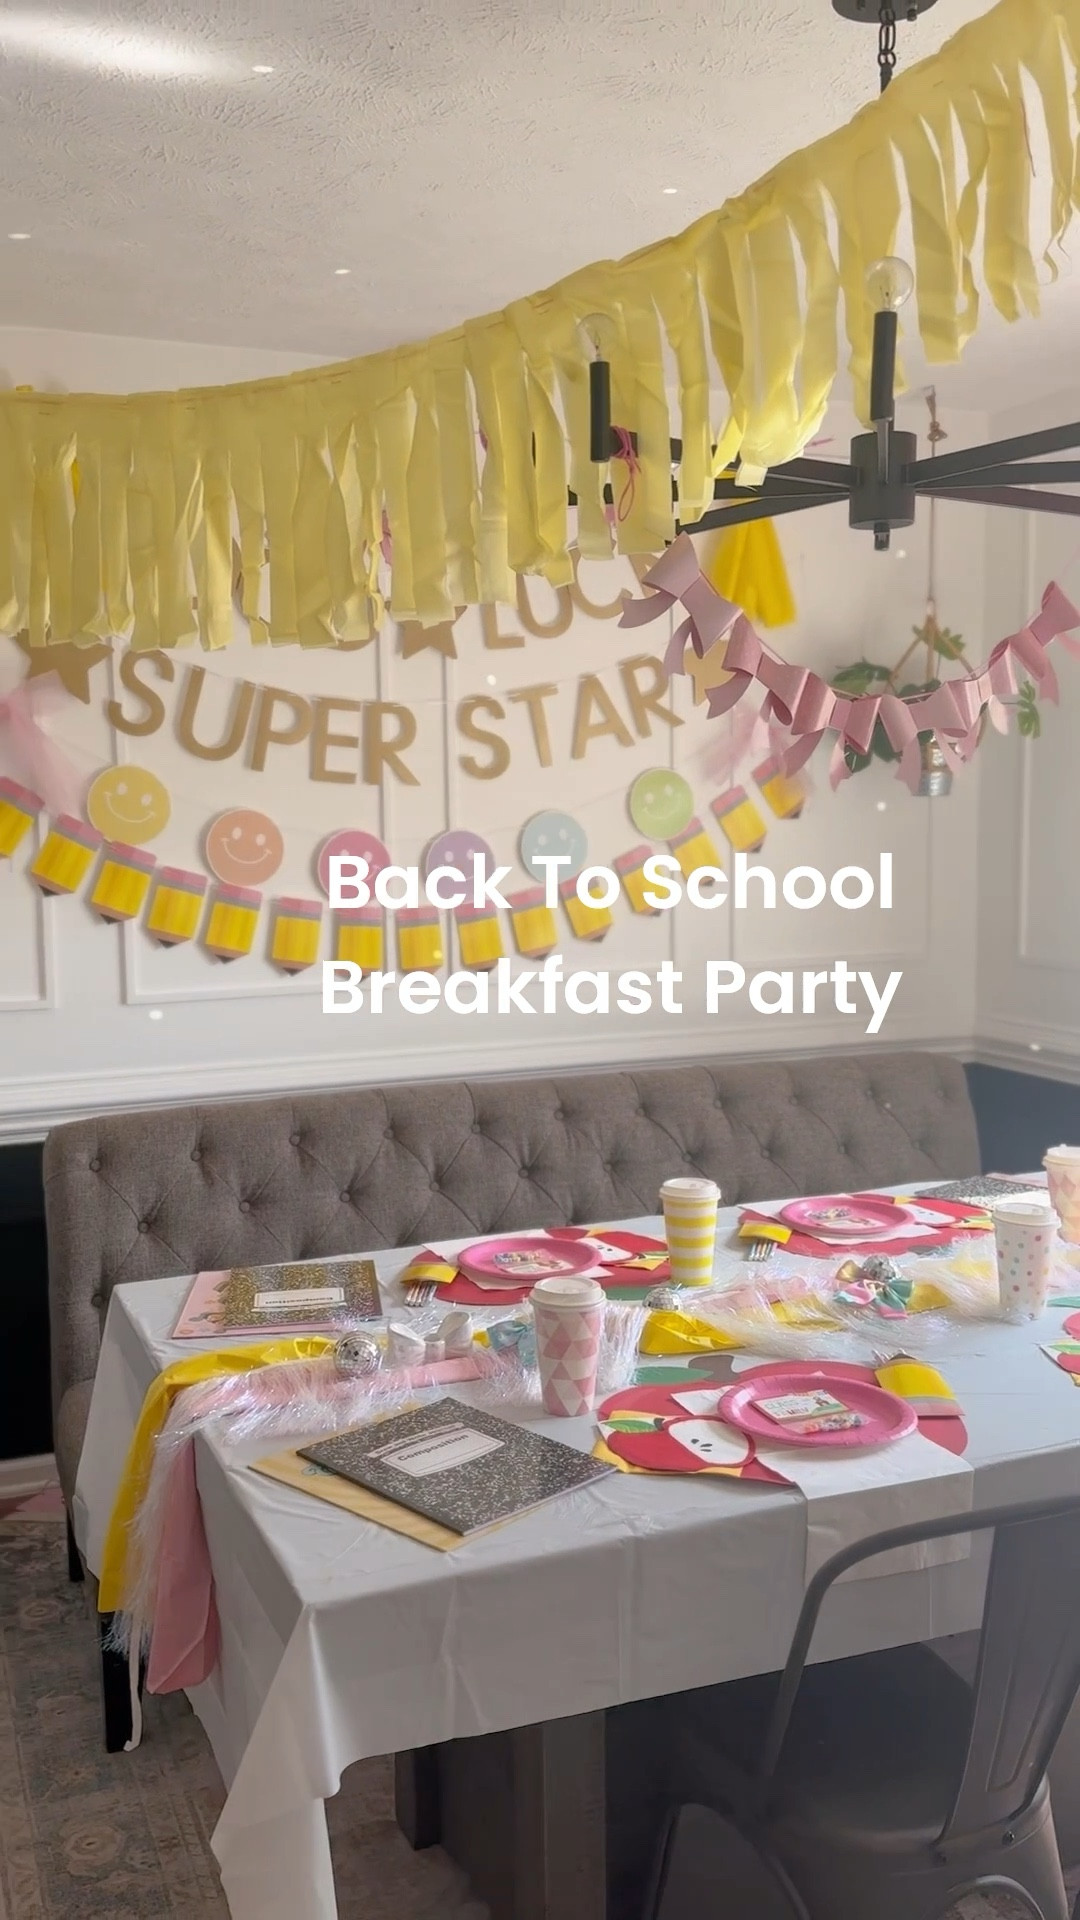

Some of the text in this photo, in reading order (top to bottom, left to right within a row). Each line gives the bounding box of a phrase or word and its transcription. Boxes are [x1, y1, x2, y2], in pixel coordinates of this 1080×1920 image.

[107, 648, 686, 787] SUPER STAR
[398, 1434, 469, 1461] Composition
